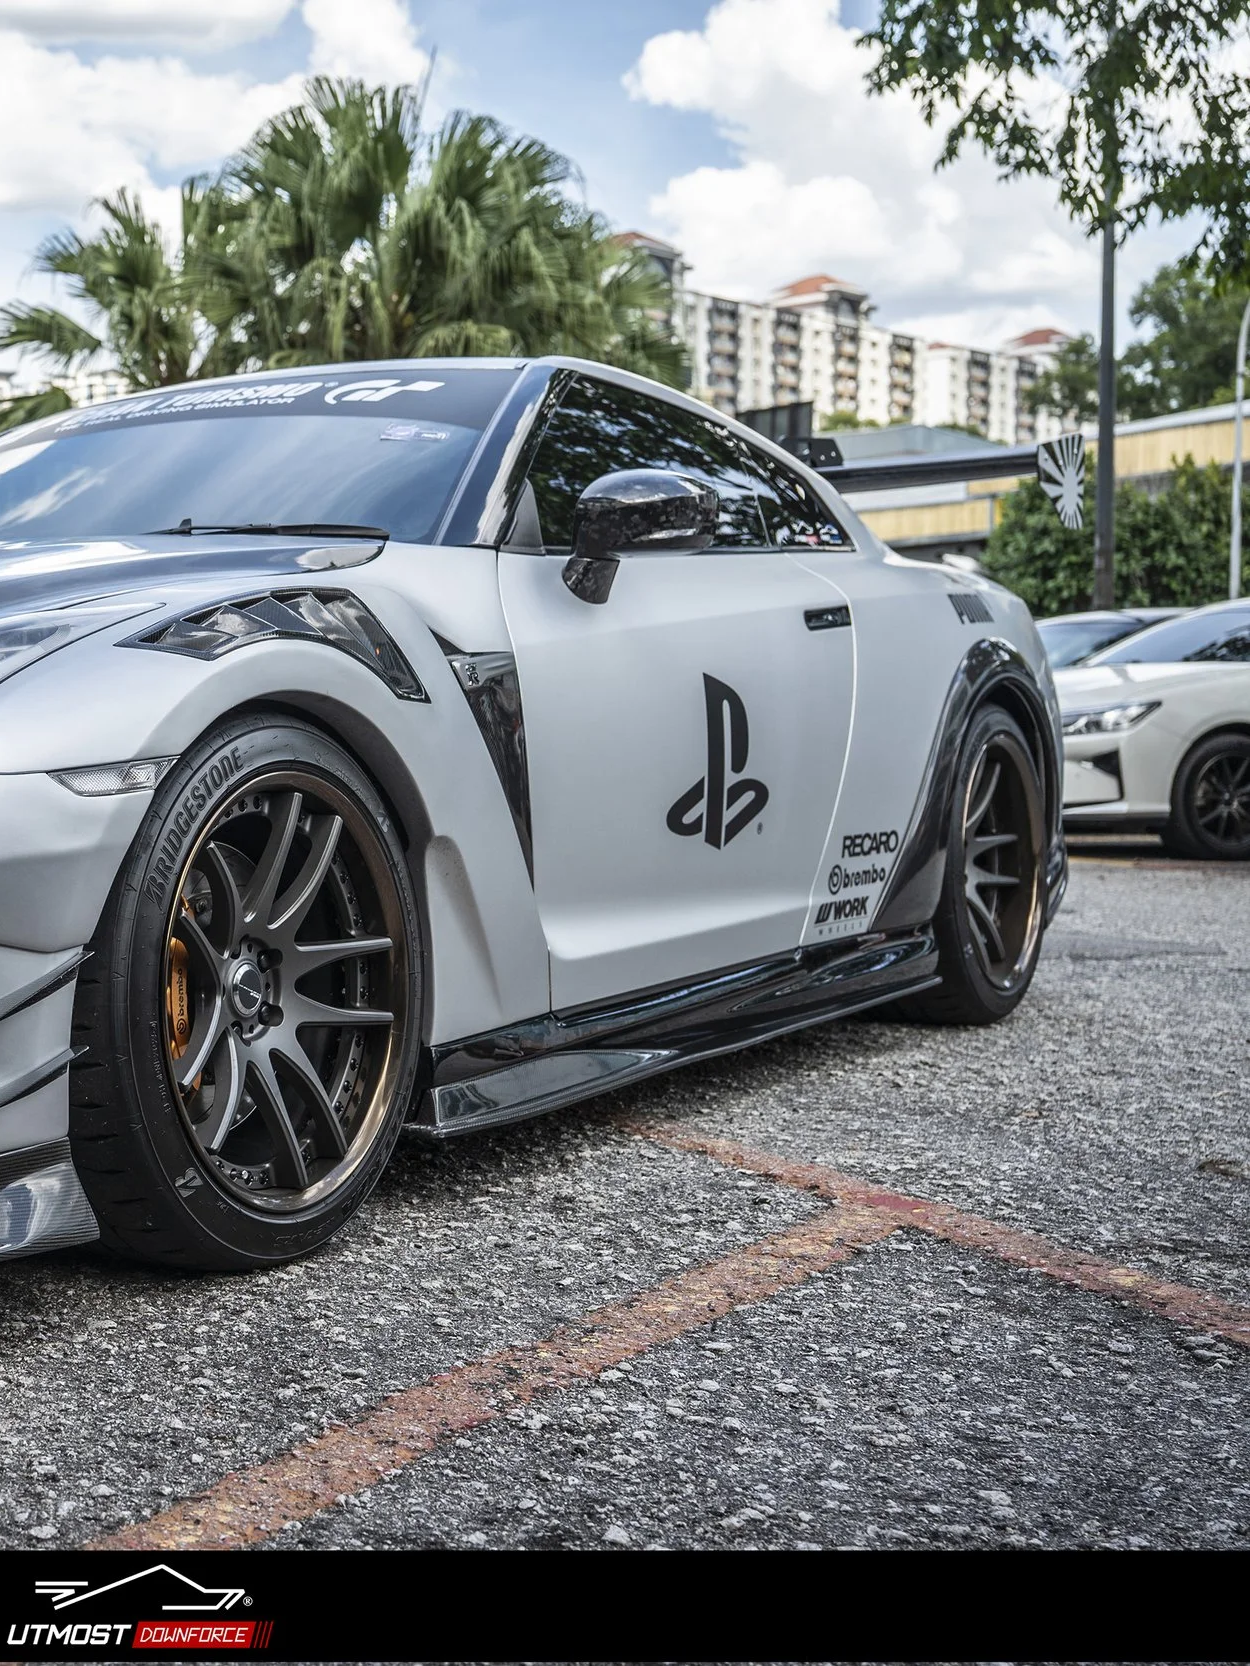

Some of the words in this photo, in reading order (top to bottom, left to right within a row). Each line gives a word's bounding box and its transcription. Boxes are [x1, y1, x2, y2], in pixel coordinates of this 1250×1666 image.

[126, 404, 193, 419] DRIVING
[194, 397, 296, 411] SIMULATOR
[156, 382, 323, 409] TURISMO
[144, 745, 245, 911] BRIDGESTONE
[841, 829, 899, 858] RECARO
[842, 863, 886, 889] brembo
[833, 896, 870, 920] WORK
[177, 967, 186, 1017] brembo
